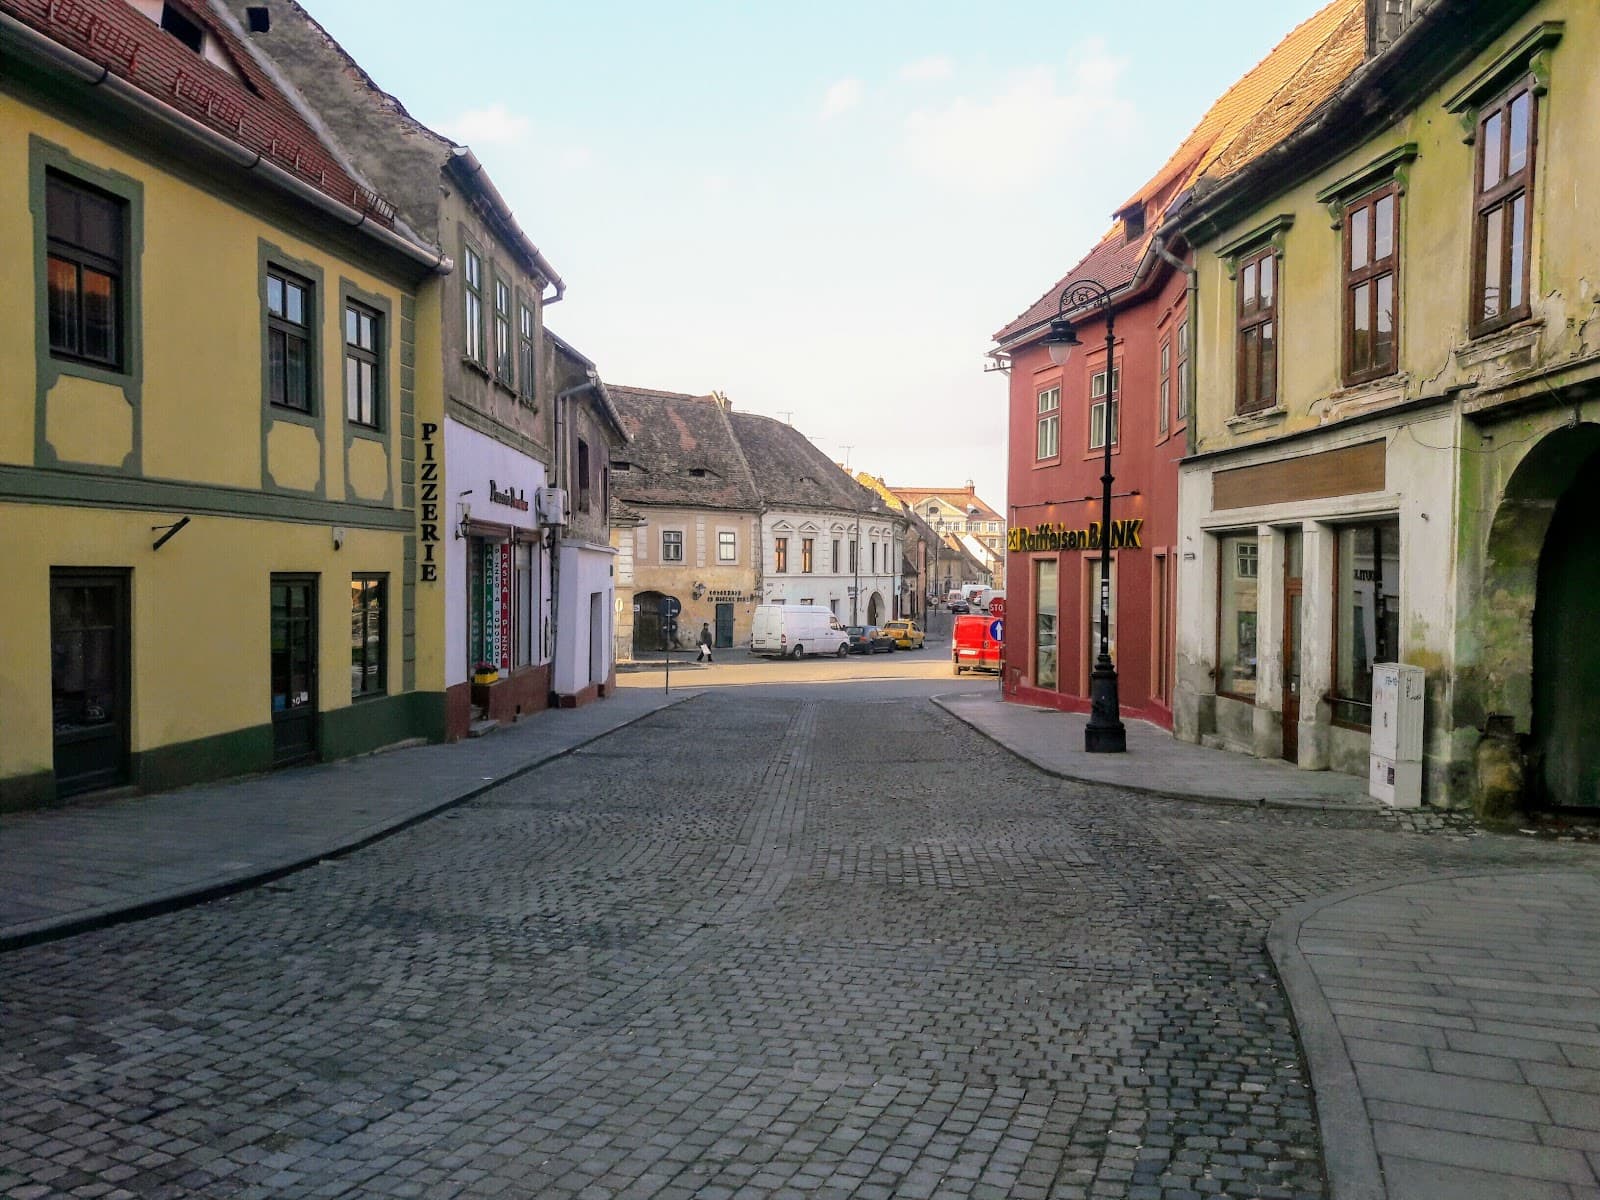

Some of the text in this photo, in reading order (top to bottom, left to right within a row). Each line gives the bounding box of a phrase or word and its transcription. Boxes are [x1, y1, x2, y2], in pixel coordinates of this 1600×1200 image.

[420, 423, 440, 582] PIZZERIE
[1020, 522, 1089, 551] Raiffeisen
[990, 604, 1003, 612] STO
